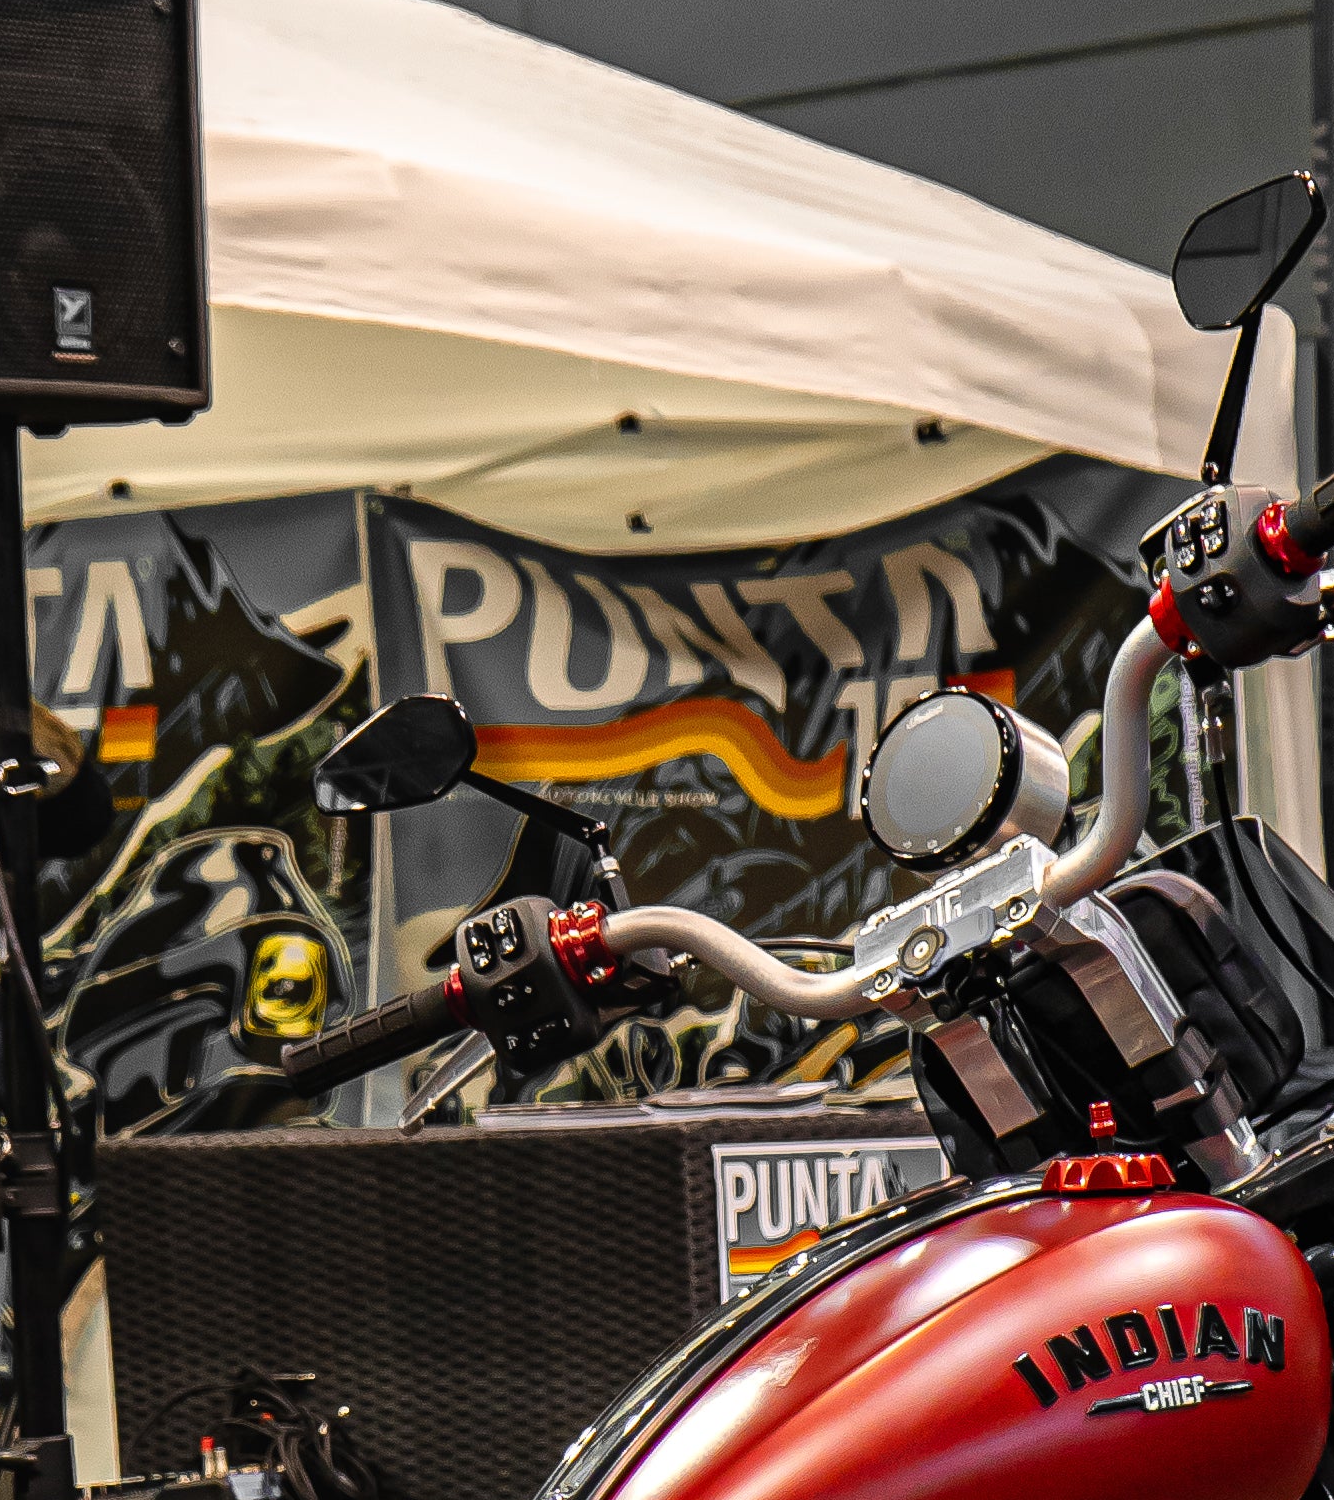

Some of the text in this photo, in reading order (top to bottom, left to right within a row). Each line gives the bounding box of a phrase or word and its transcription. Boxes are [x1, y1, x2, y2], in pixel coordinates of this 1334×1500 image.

[408, 538, 999, 713] PUNTA
[723, 1156, 889, 1244] PUNTA
[1012, 1301, 1287, 1409] INDIAN
[1139, 1374, 1208, 1412] CHIEF
